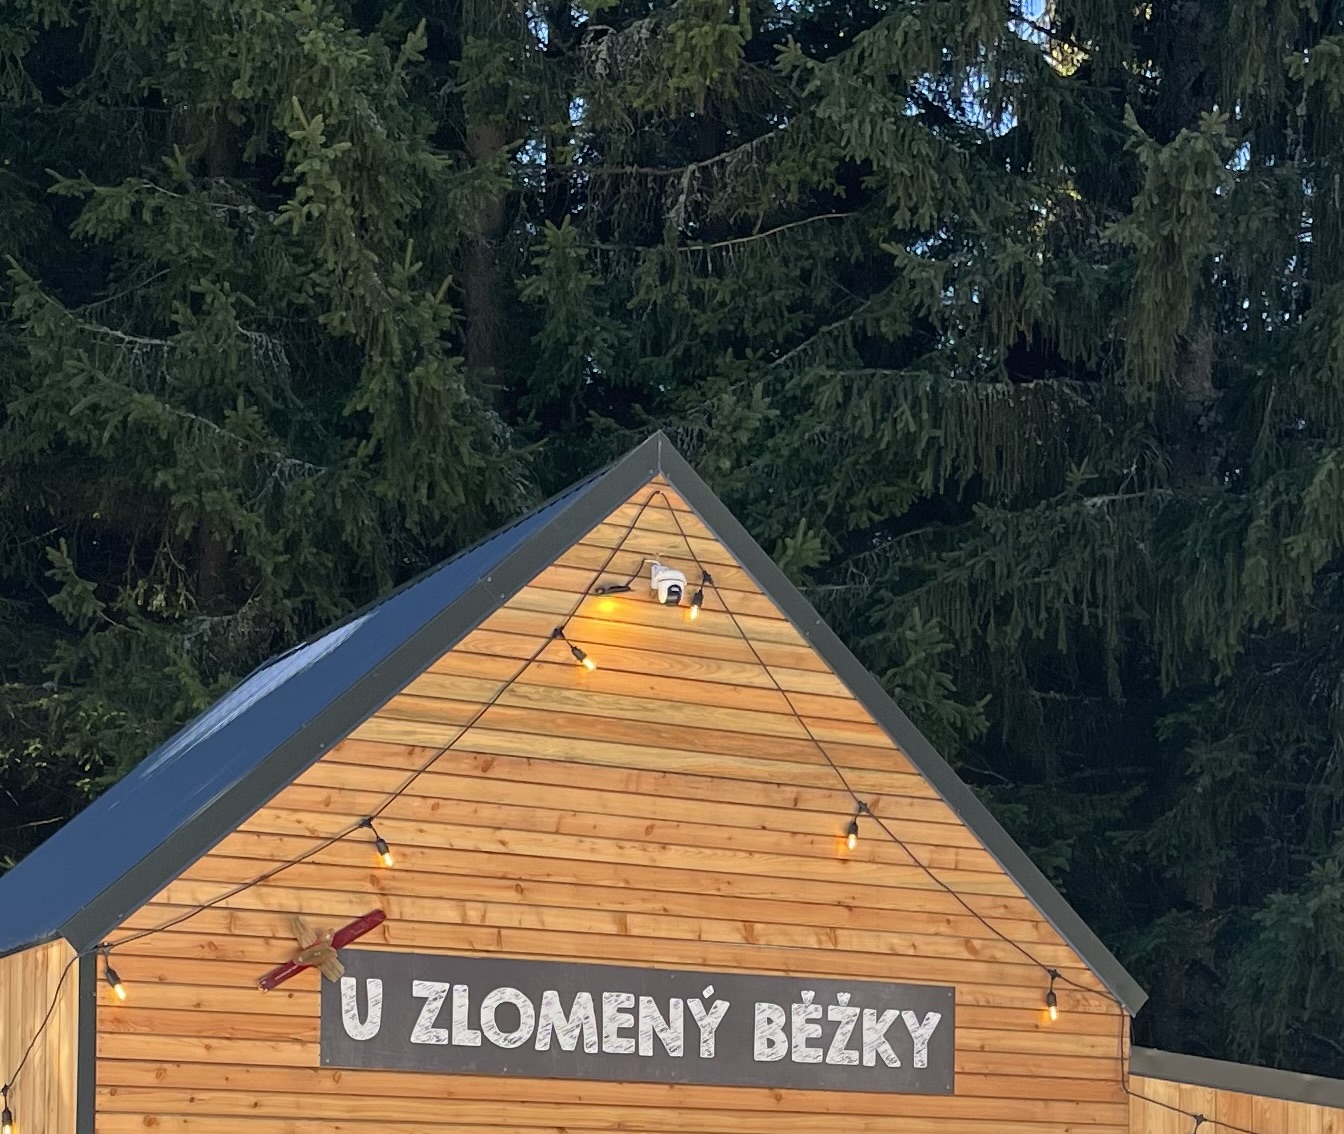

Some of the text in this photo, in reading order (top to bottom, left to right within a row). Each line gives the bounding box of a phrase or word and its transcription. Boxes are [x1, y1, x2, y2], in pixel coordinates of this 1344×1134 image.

[340, 976, 943, 1069] U ZLOMENÝ BĚŽKY
